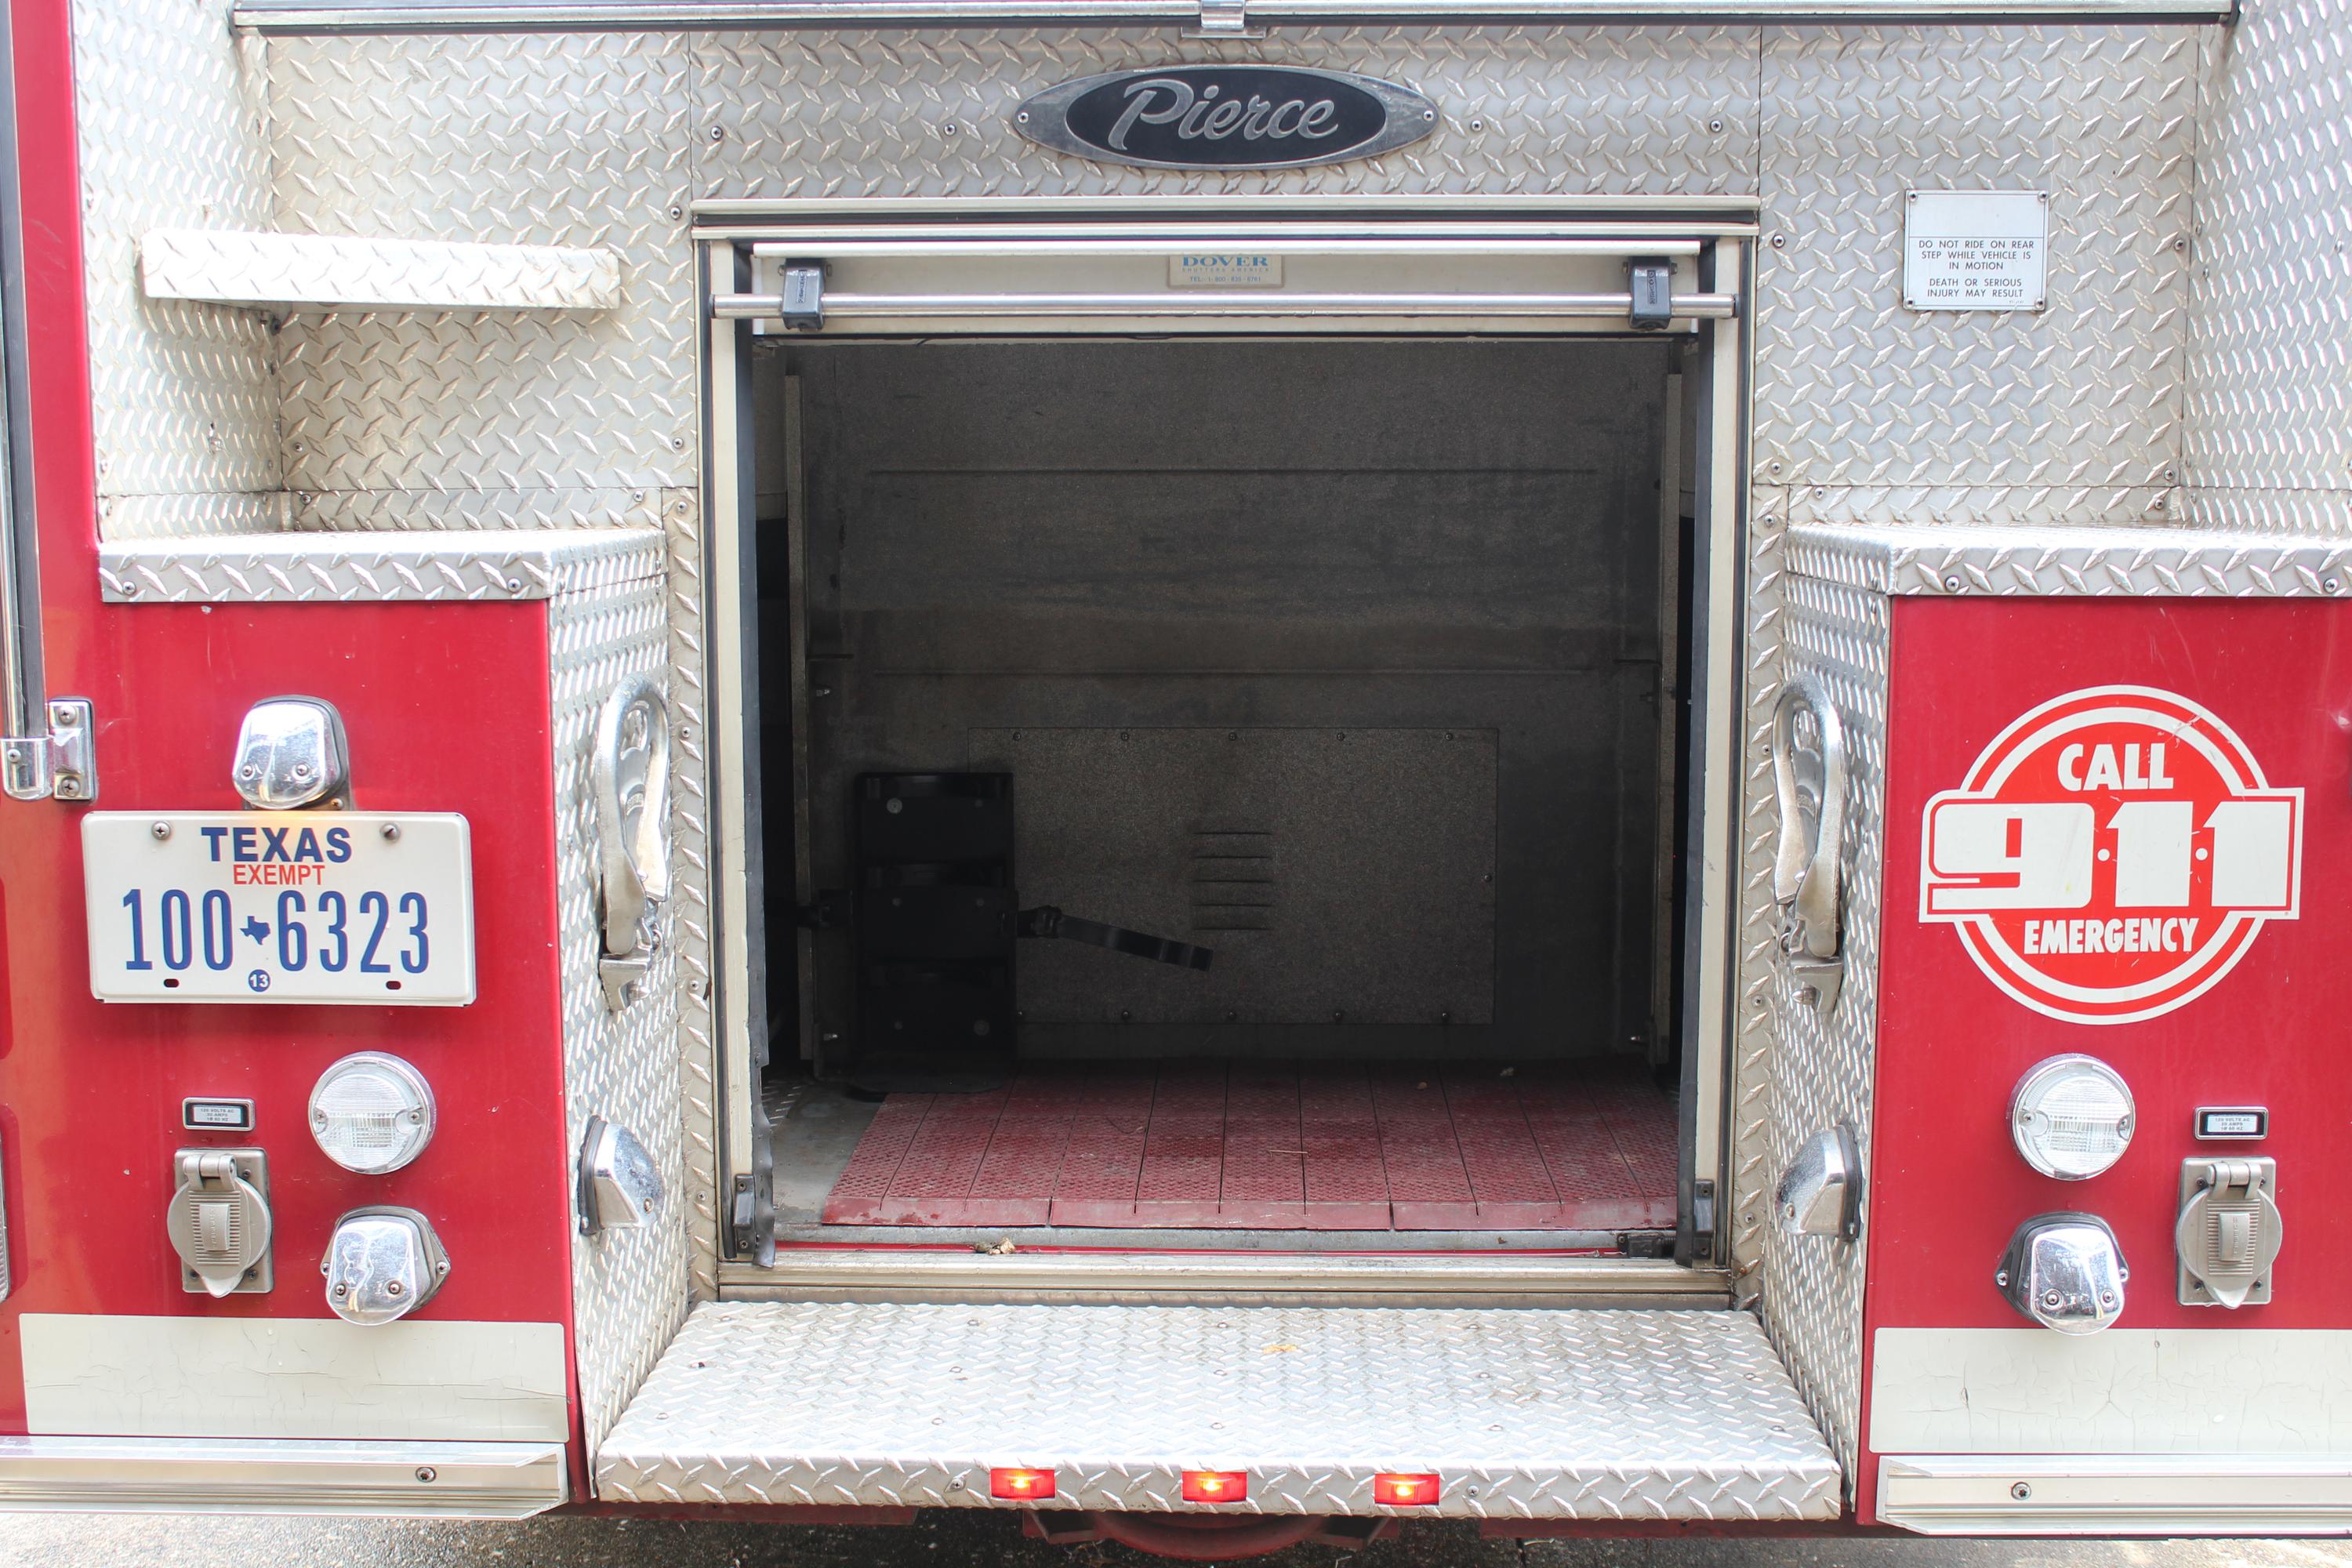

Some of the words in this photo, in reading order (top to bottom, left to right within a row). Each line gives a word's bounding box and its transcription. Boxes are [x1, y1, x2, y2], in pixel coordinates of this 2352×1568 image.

[1108, 78, 1339, 151] Pierce
[1918, 240, 1933, 249] DO
[1939, 240, 1959, 249] NOT
[1964, 240, 1984, 249] RIDE
[1990, 240, 2005, 249] ON
[1183, 256, 1268, 267] DOVER
[1922, 251, 1942, 260] STEP
[1947, 251, 1976, 260] WHILE
[1981, 251, 2017, 260] VEHICLE
[2023, 251, 2031, 260] IS
[1949, 261, 1959, 270] IN
[1965, 261, 2004, 270] MOTION
[1929, 278, 1958, 286] DEATH
[2057, 742, 2174, 792] CALL
[201, 826, 352, 863] TEXAS
[234, 864, 325, 886] EXEMPT
[2024, 916, 2200, 955] EMERGENCY
[249, 973, 269, 988] 13
